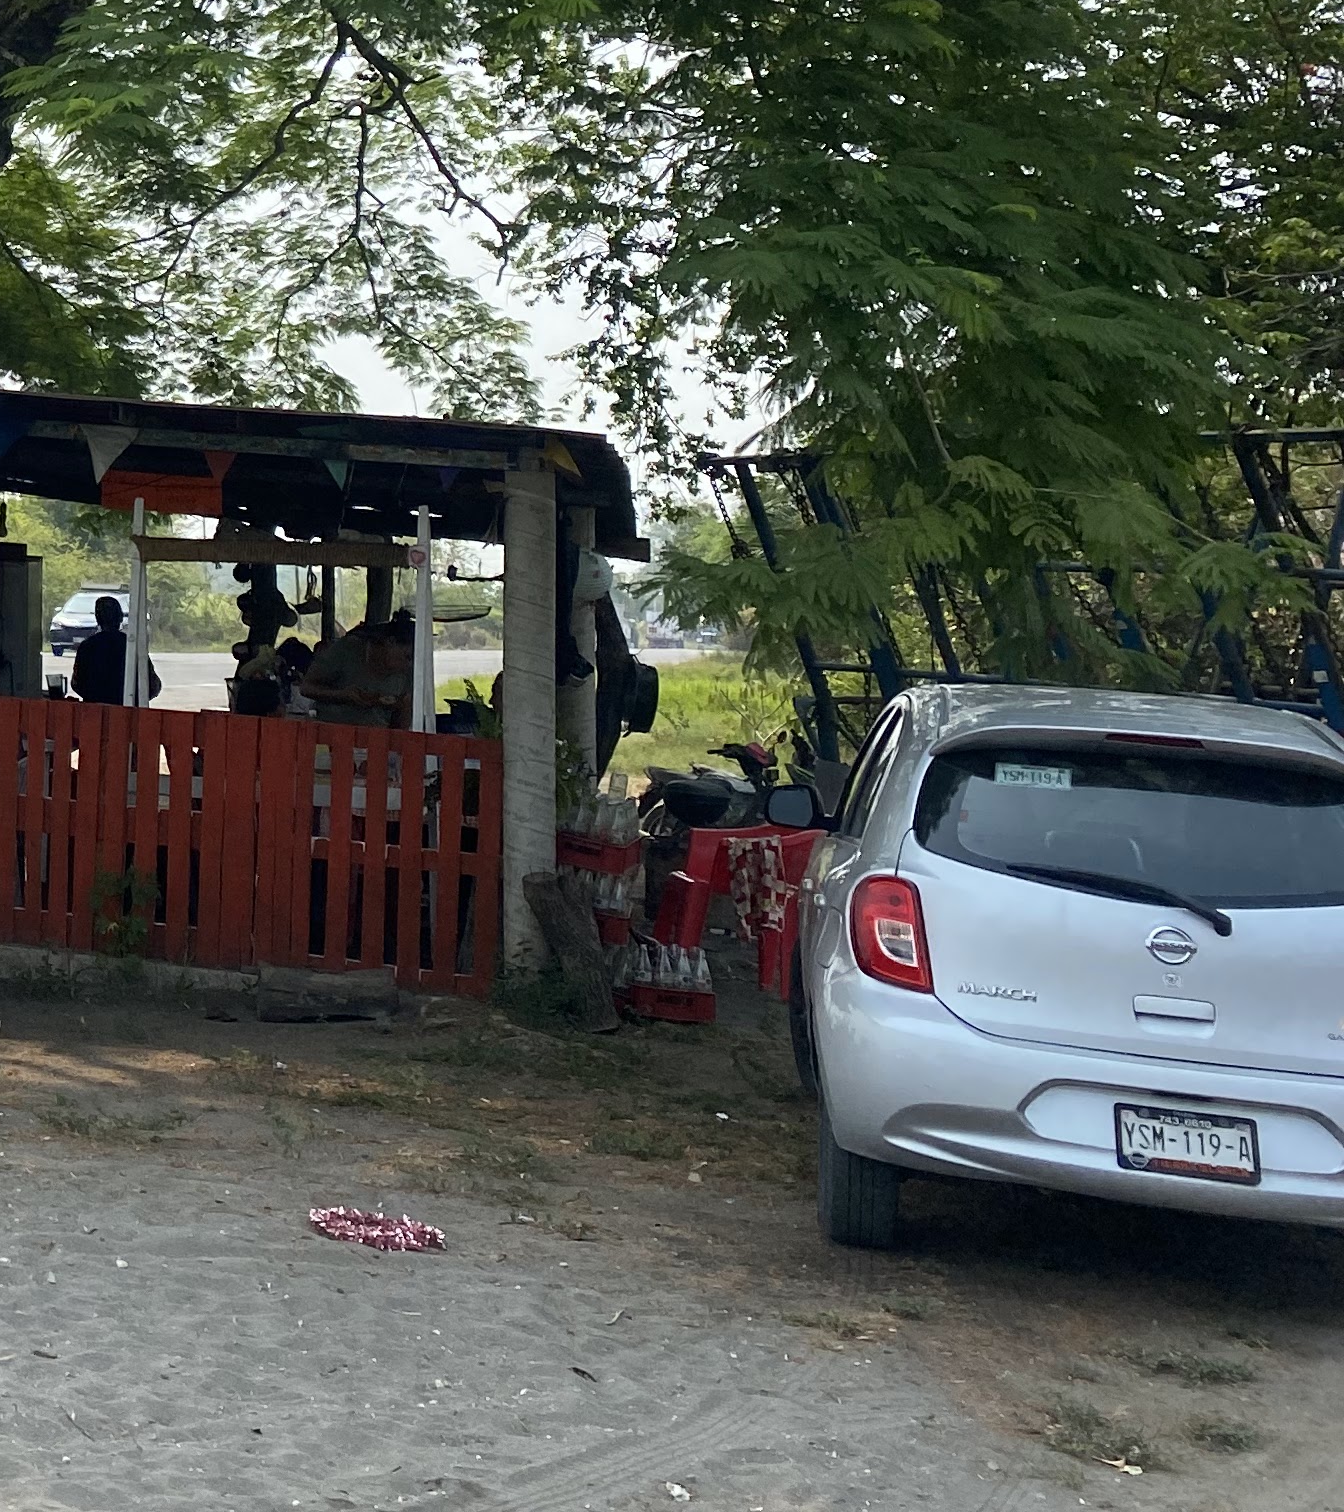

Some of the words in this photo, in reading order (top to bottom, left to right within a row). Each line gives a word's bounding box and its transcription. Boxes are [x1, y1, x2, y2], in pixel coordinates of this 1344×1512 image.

[1002, 770, 1063, 786] YSM-119-A
[957, 982, 1038, 1003] MARCH
[1123, 1121, 1251, 1163] YSM-119-A
